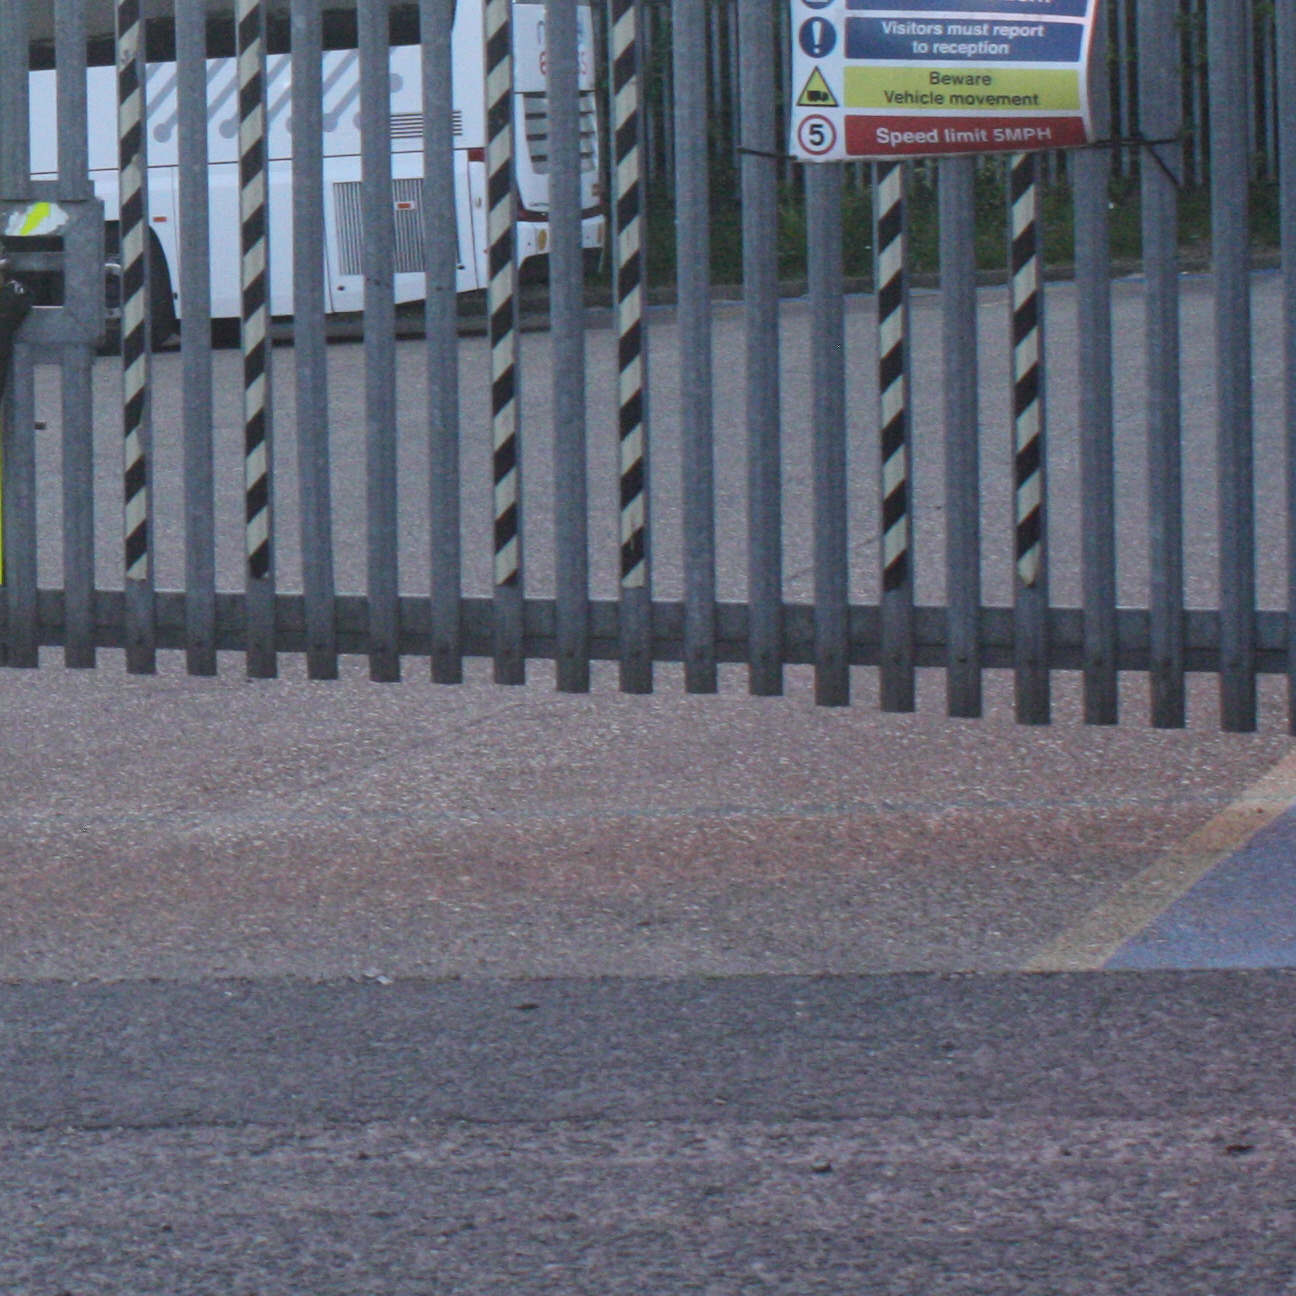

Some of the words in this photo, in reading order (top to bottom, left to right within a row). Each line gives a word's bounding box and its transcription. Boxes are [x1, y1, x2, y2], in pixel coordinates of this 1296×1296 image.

[882, 21, 942, 36] Visitors
[947, 24, 989, 36] must
[993, 25, 1044, 39] report
[912, 41, 928, 53] to
[933, 41, 1010, 56] reception
[930, 72, 992, 86] Beware
[884, 91, 943, 104] Vehicle
[949, 93, 1039, 106] movement
[809, 124, 825, 146] 5
[876, 128, 940, 146] Speed
[945, 129, 987, 142] limit
[994, 127, 1051, 142] 5MPH
